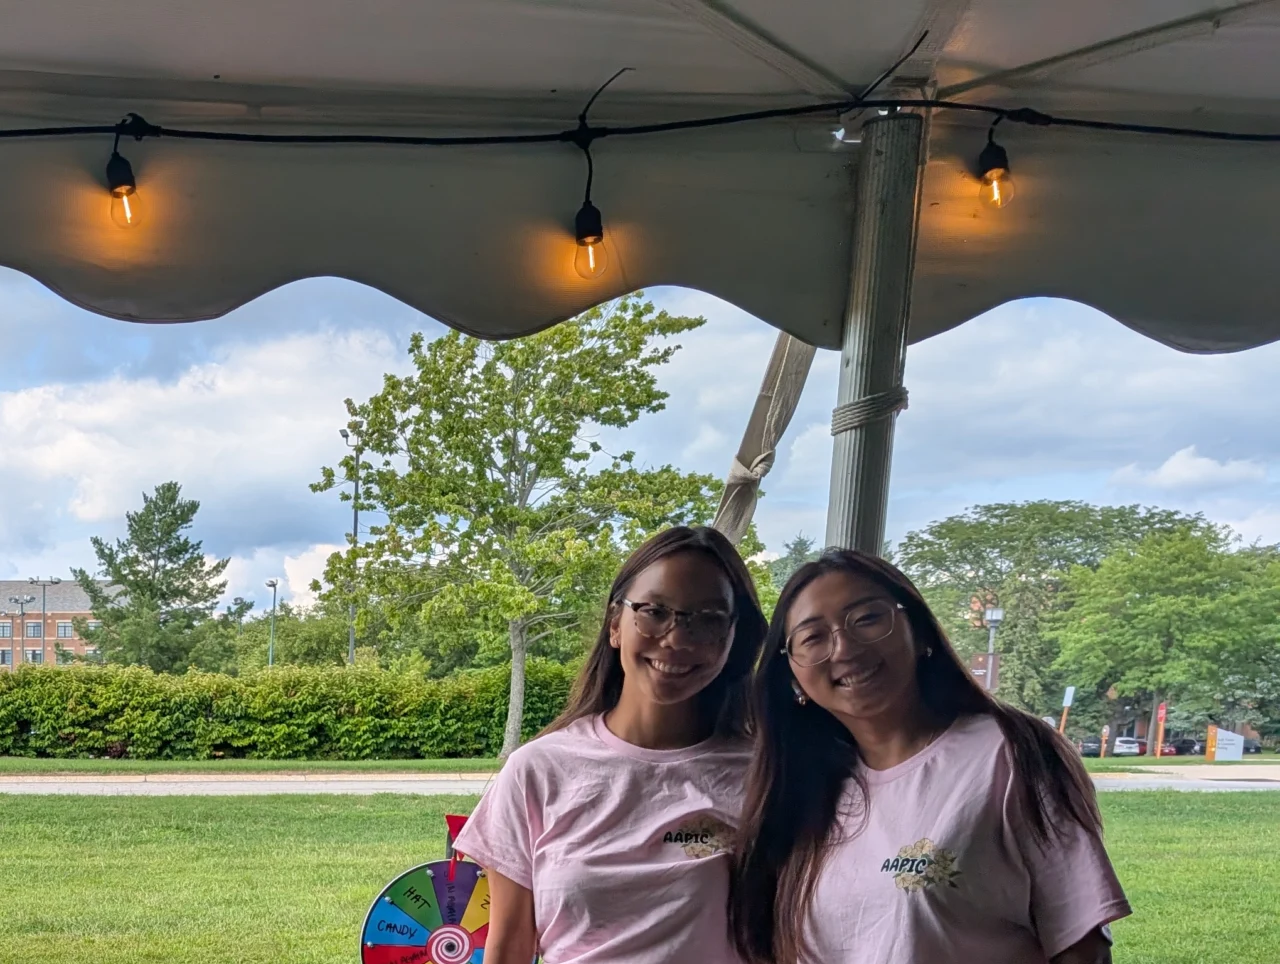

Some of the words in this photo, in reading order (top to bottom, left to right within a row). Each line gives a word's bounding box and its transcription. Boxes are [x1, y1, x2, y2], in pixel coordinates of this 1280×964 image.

[663, 830, 710, 844] AAPIC
[881, 858, 928, 874] AAPIC
[403, 886, 431, 910] HAT
[377, 920, 418, 940] CANDY
